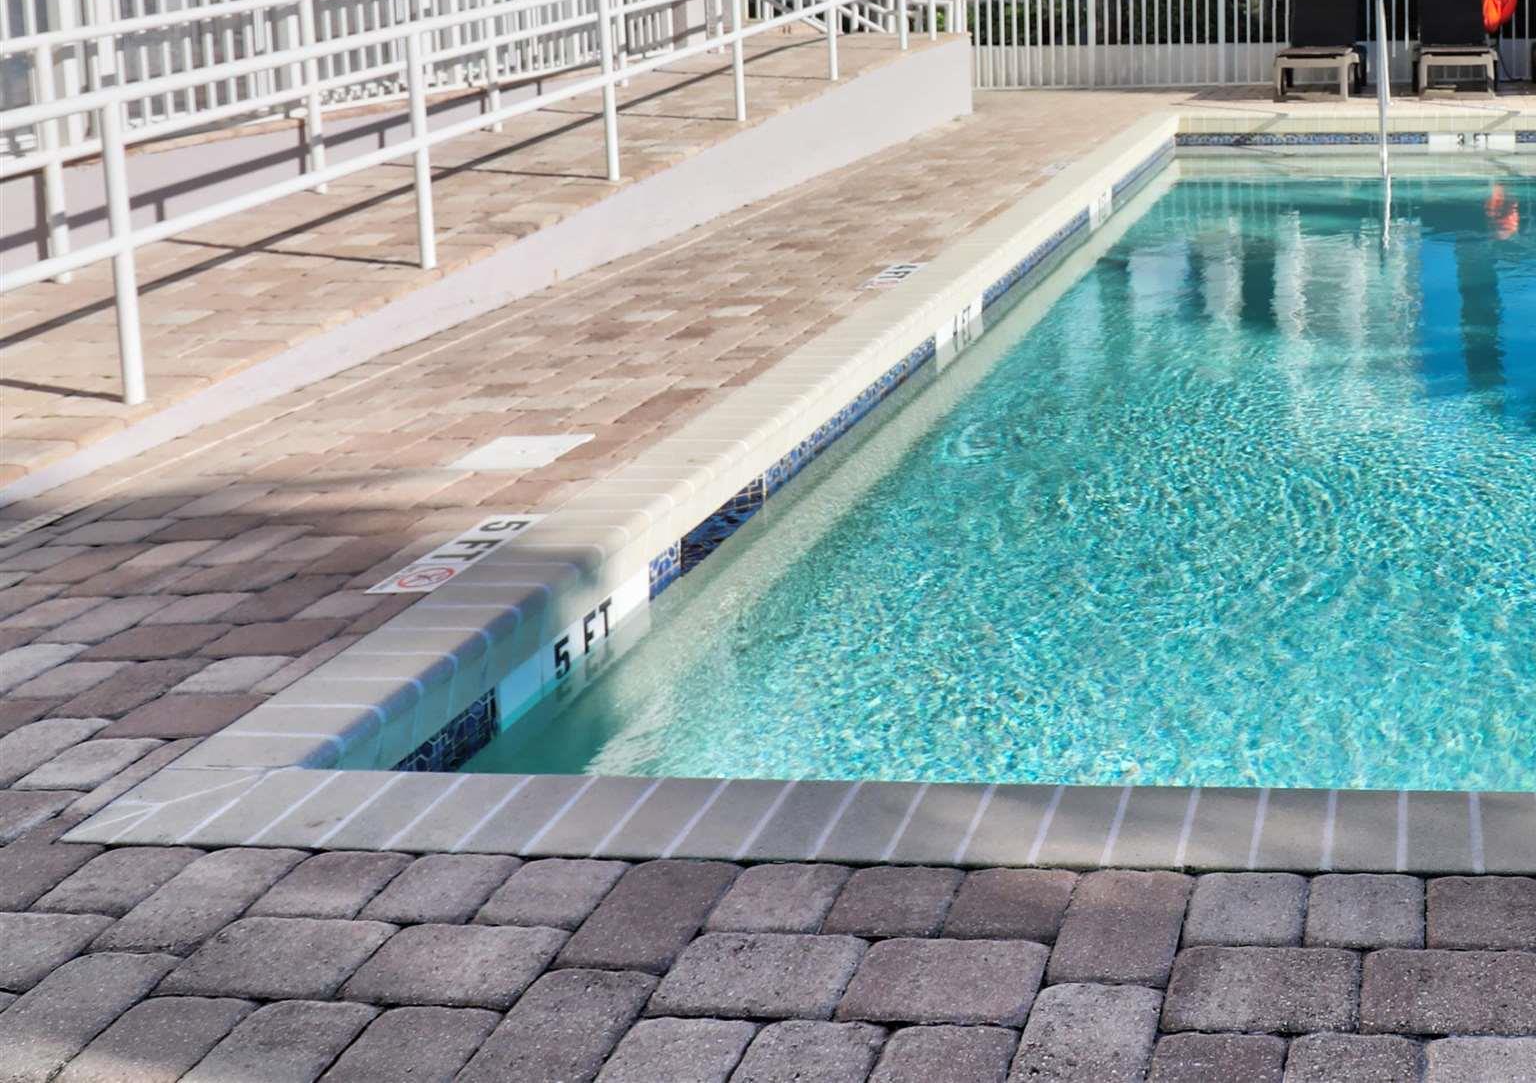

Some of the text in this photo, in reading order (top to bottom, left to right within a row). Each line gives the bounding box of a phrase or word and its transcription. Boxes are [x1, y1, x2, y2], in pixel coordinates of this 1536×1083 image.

[1456, 132, 1491, 147] 3 FT
[432, 520, 531, 562] 5 FT
[554, 597, 612, 680] 5 FT
